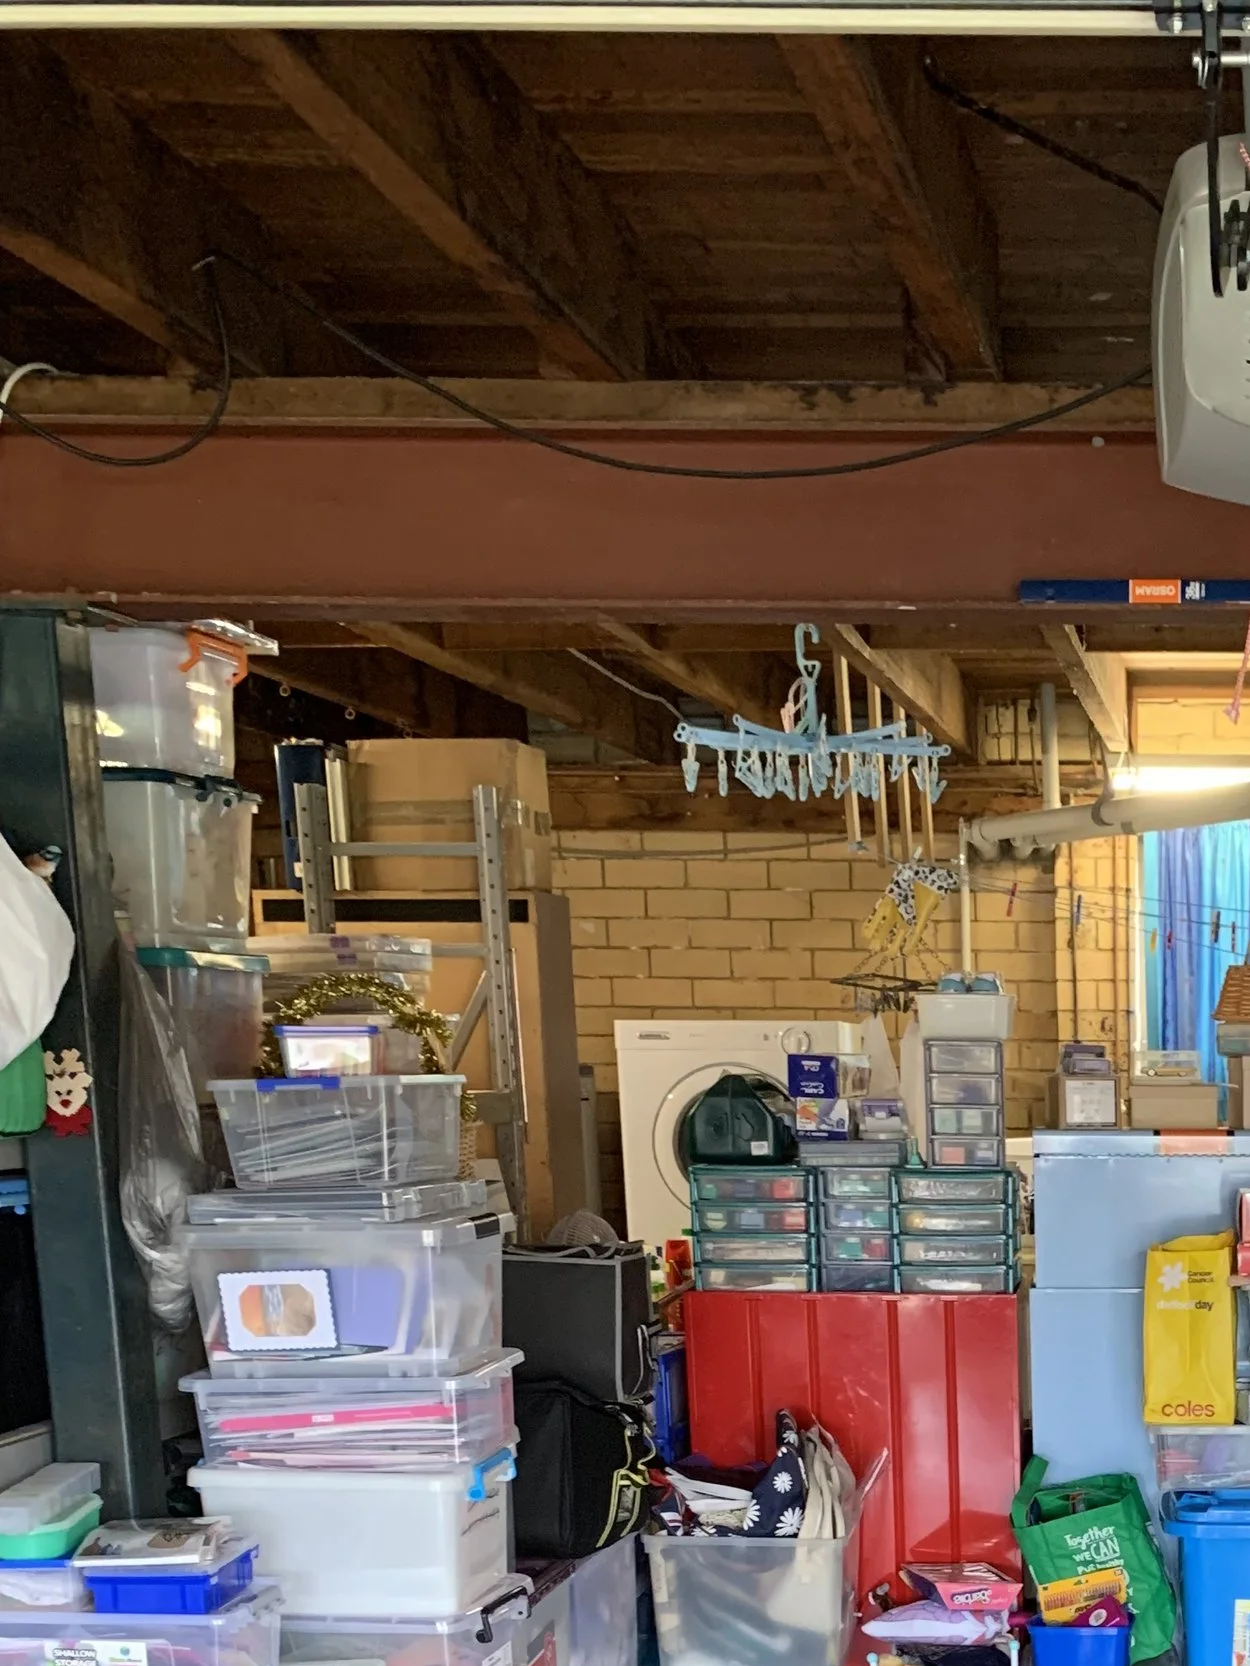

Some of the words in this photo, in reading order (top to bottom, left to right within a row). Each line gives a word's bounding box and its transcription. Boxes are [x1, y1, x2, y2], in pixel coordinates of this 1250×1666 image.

[1135, 584, 1175, 597] OSRAM
[1195, 1300, 1214, 1311] day
[1161, 1400, 1215, 1417] coles
[1064, 1526, 1115, 1550] Together
[1072, 1551, 1092, 1562] WE
[1090, 1536, 1120, 1561] CAN
[952, 1589, 992, 1606] Barbie
[52, 1648, 97, 1658] SHALLOW
